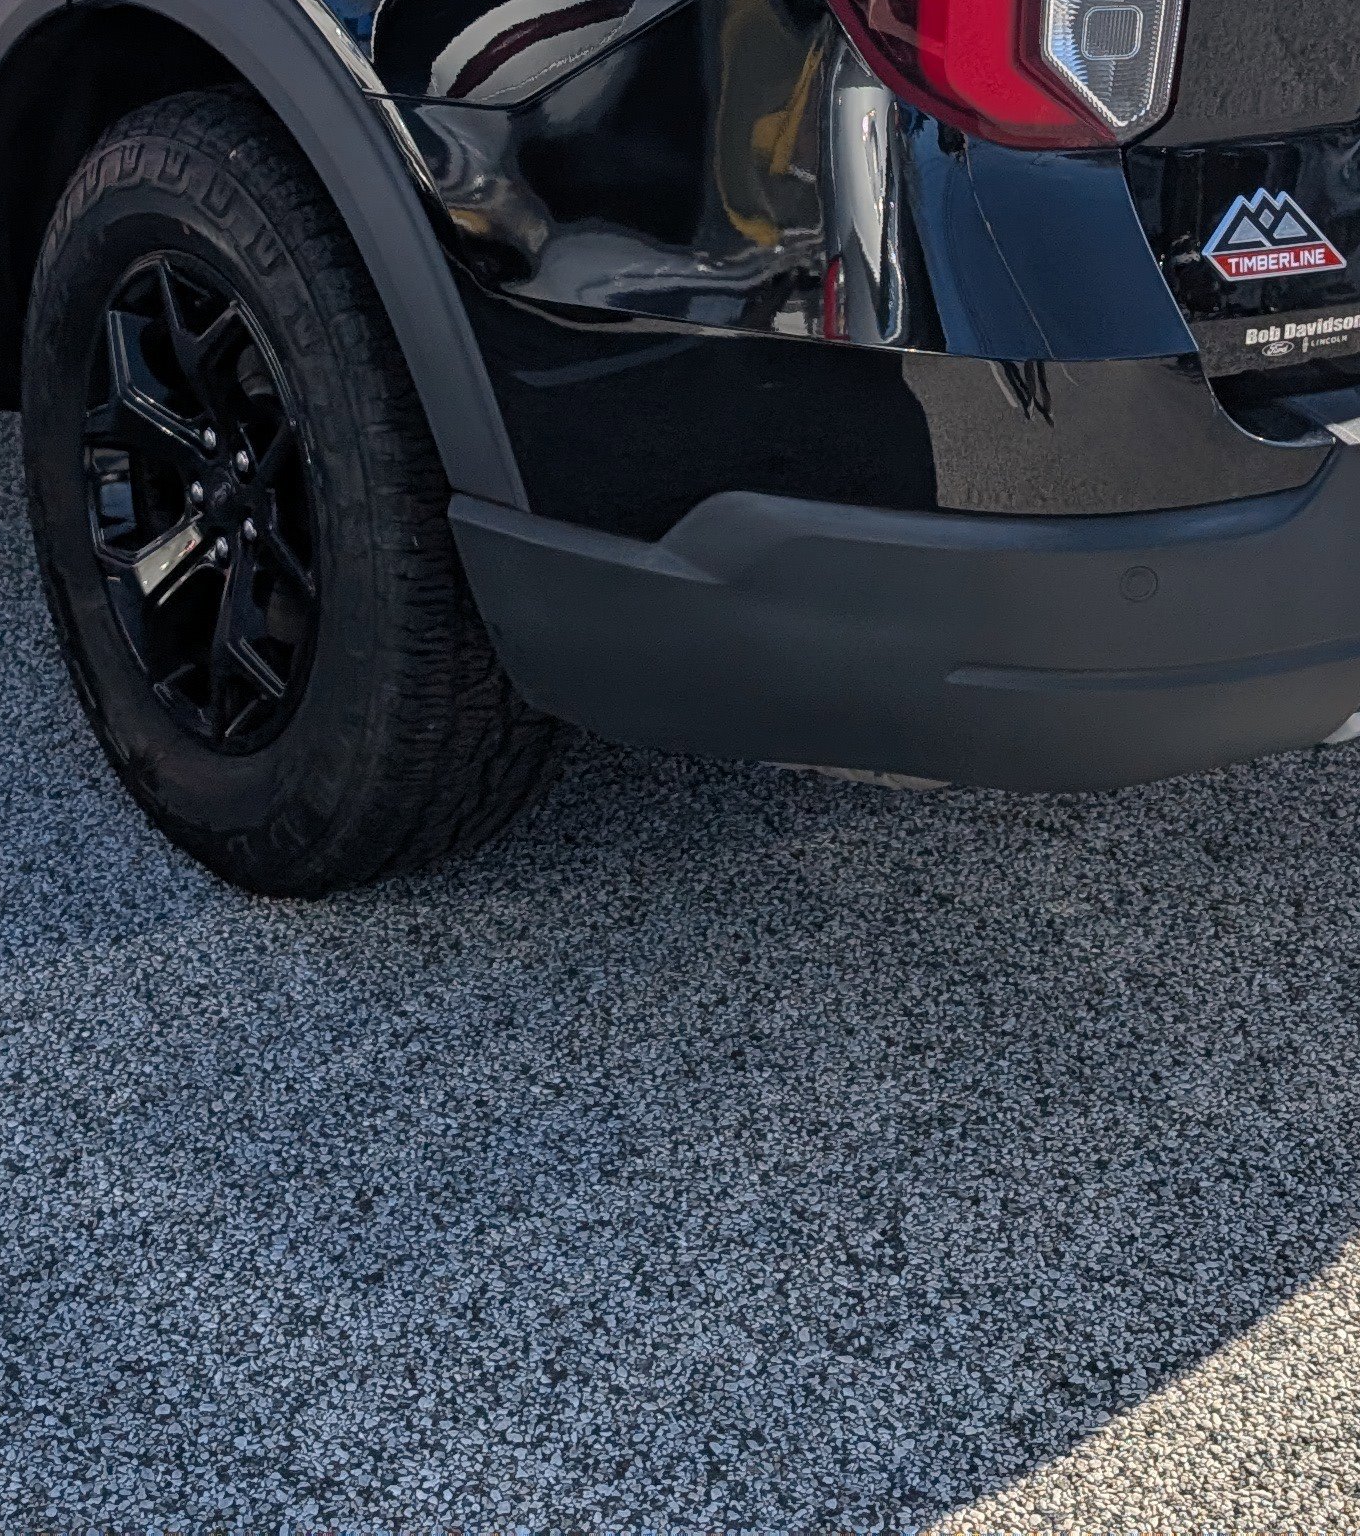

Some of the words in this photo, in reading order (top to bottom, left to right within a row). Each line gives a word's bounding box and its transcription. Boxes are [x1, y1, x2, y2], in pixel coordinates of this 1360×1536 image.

[1227, 247, 1326, 274] TIMBERLINE
[1245, 325, 1280, 346] Bob
[1310, 334, 1348, 347] LINCOLN
